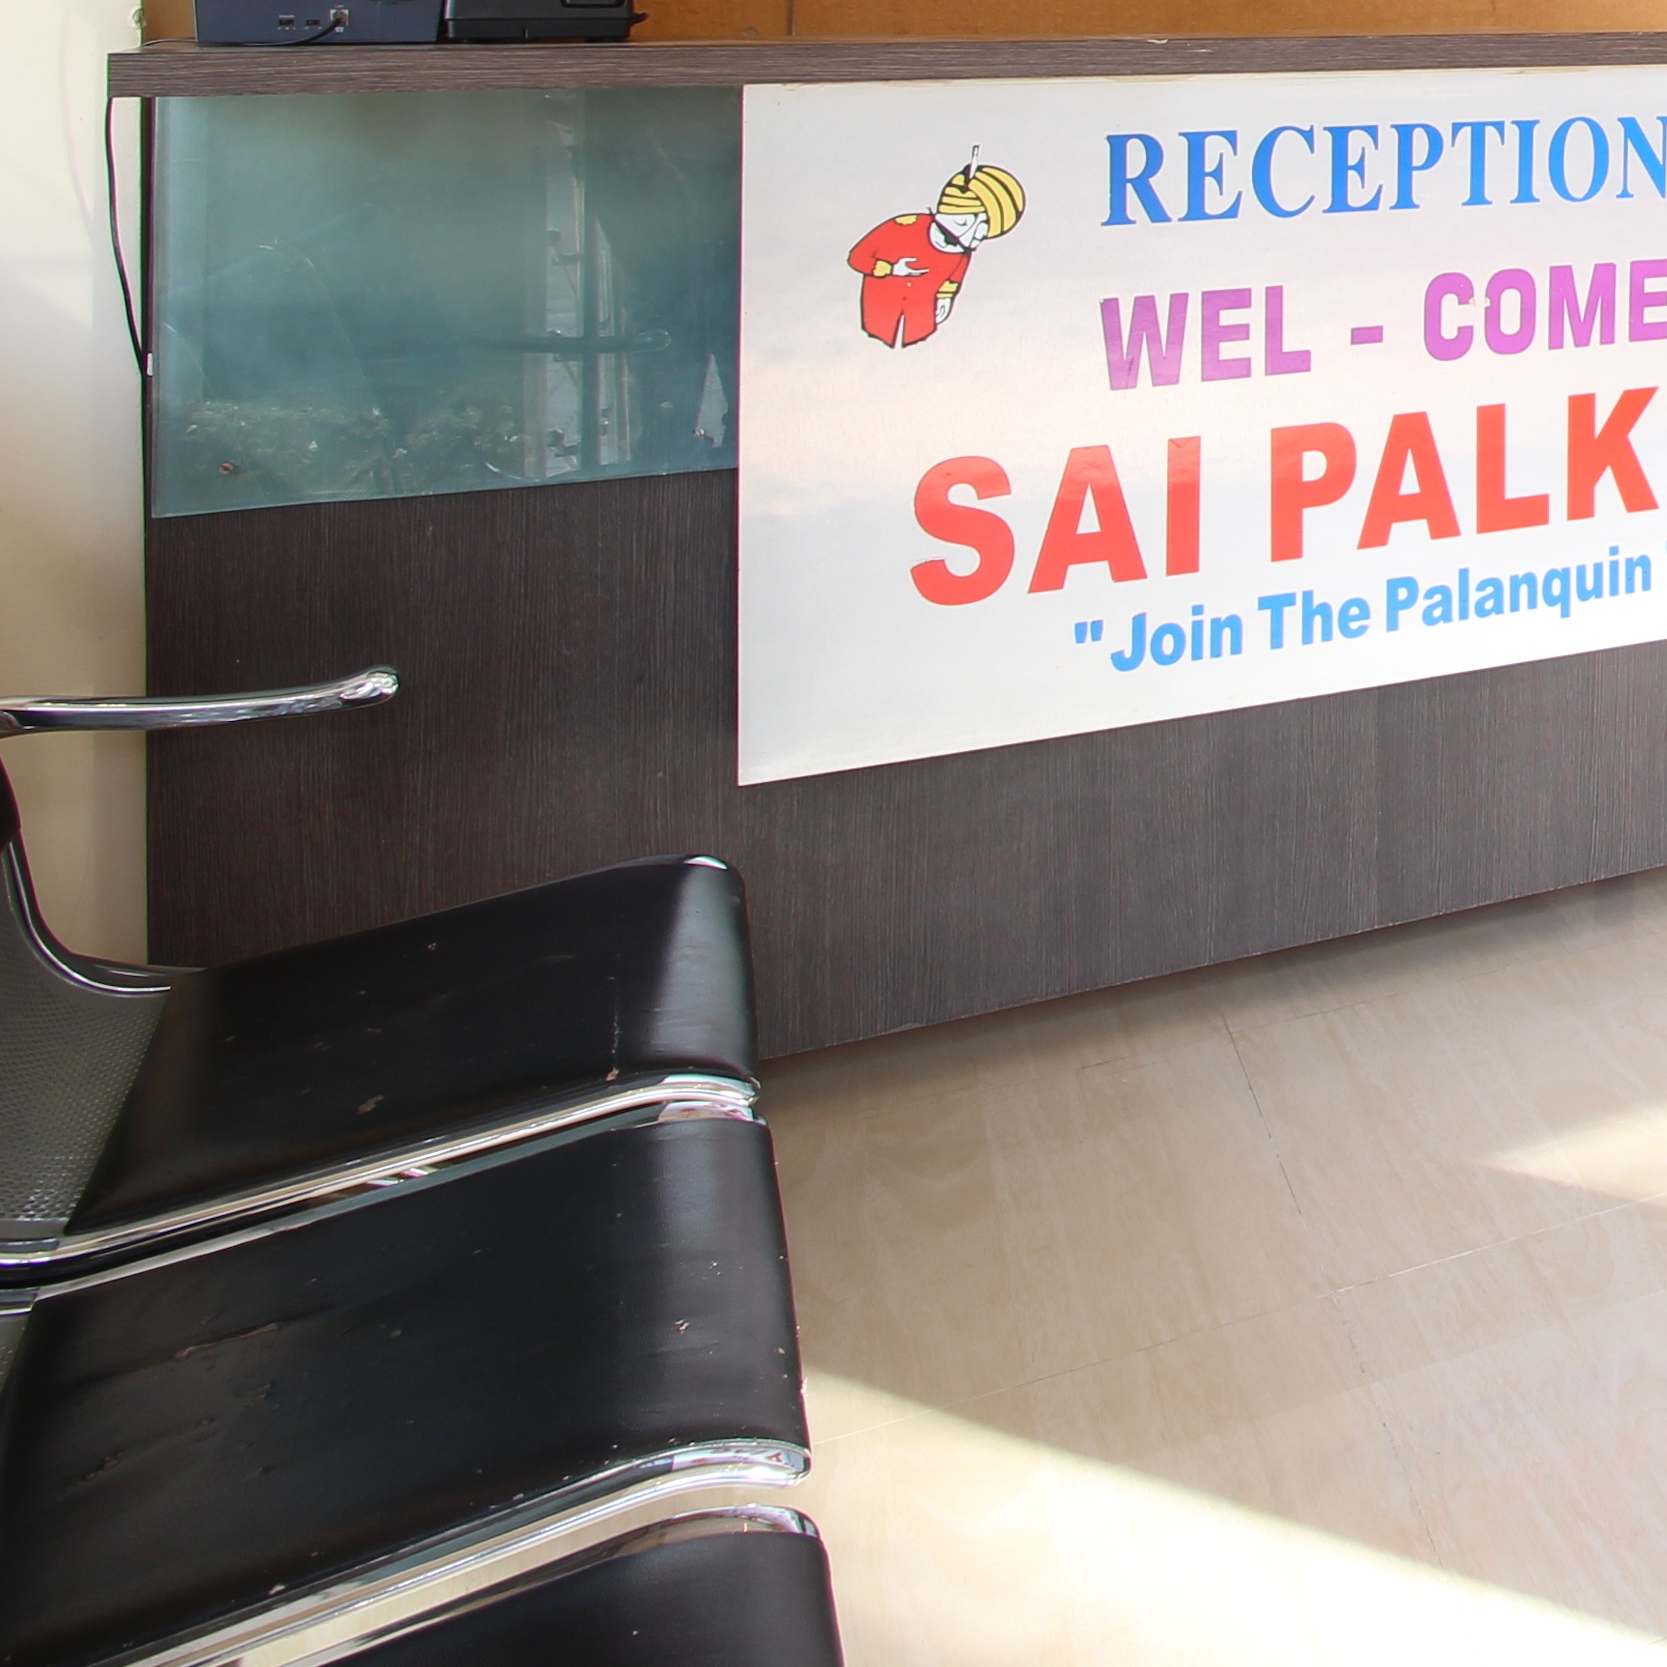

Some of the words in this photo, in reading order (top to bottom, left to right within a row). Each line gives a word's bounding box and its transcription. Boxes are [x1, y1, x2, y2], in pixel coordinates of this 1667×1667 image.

[1099, 284, 1312, 391] WEL
[909, 434, 1202, 607] SAI
[1257, 589, 1372, 651] The
[1385, 545, 1653, 633] Palanquin
